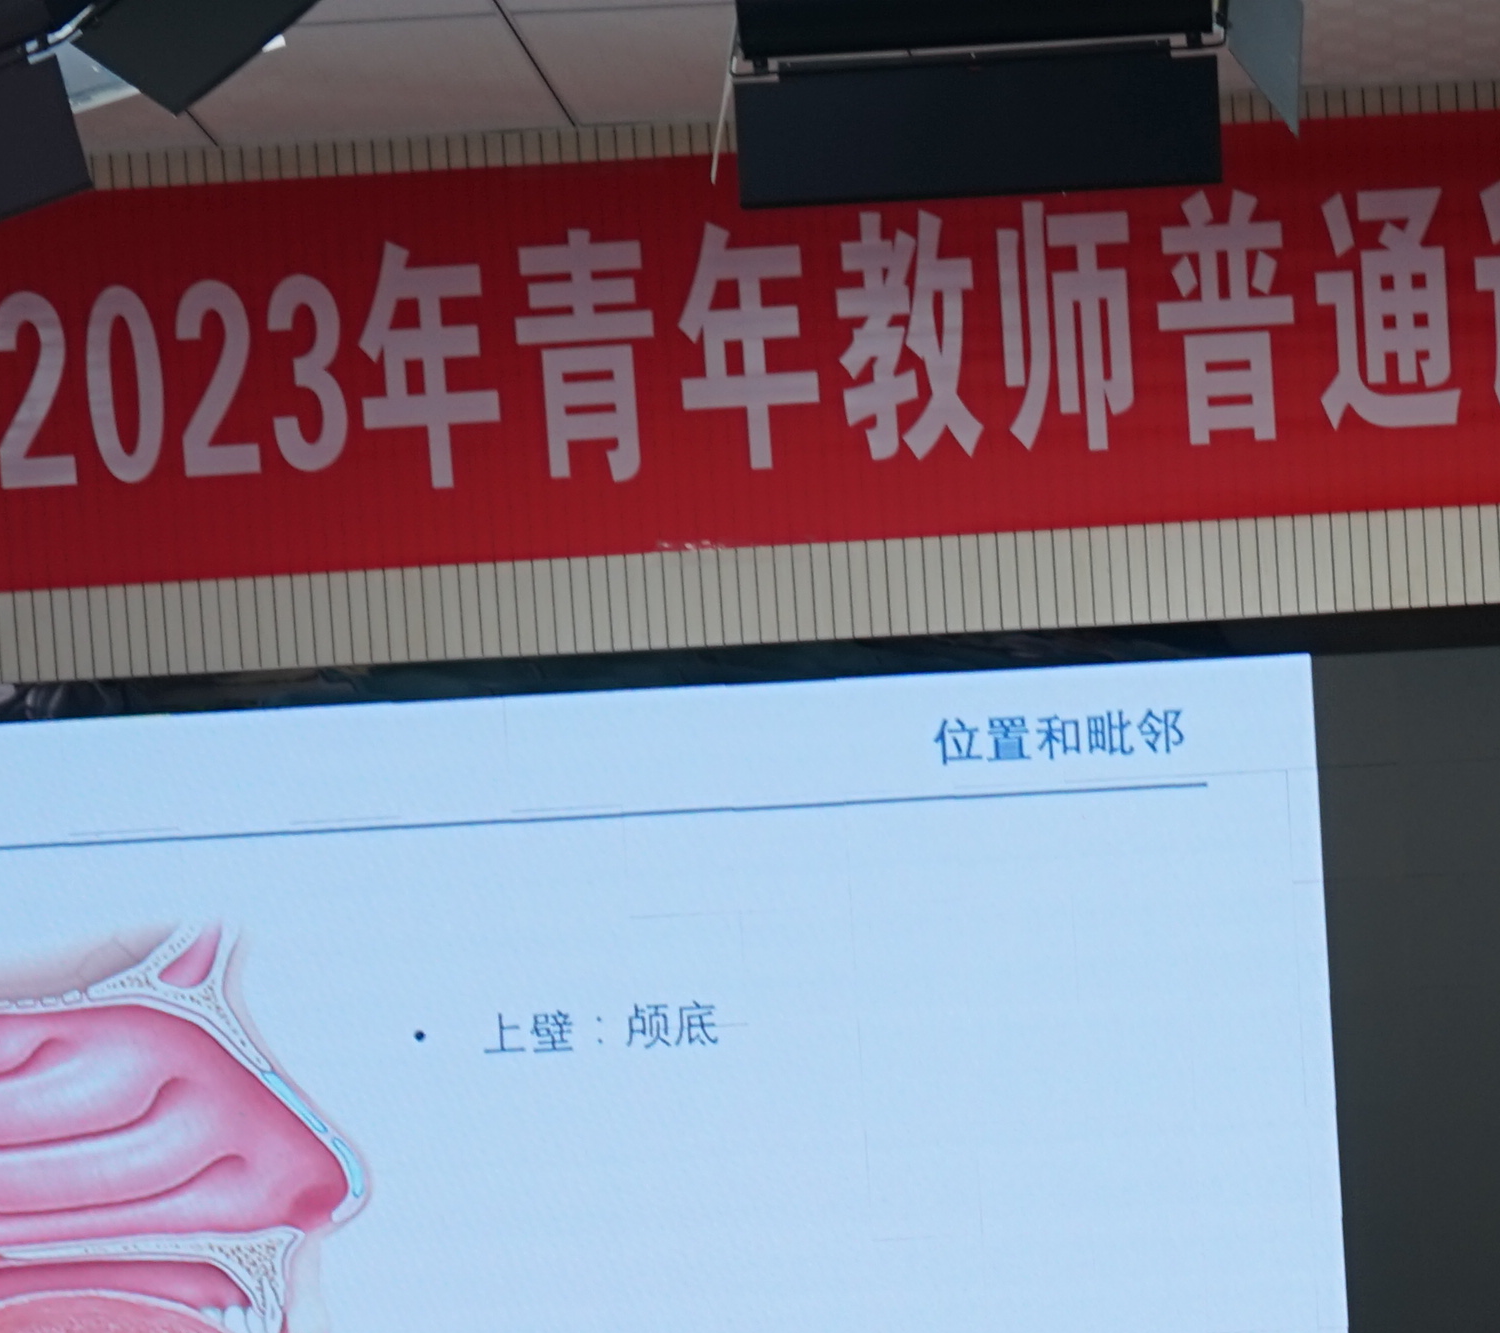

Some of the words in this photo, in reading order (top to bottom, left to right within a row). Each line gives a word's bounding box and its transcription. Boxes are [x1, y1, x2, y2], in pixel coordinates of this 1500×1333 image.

[933, 708, 1186, 766] 位置和毗邻
